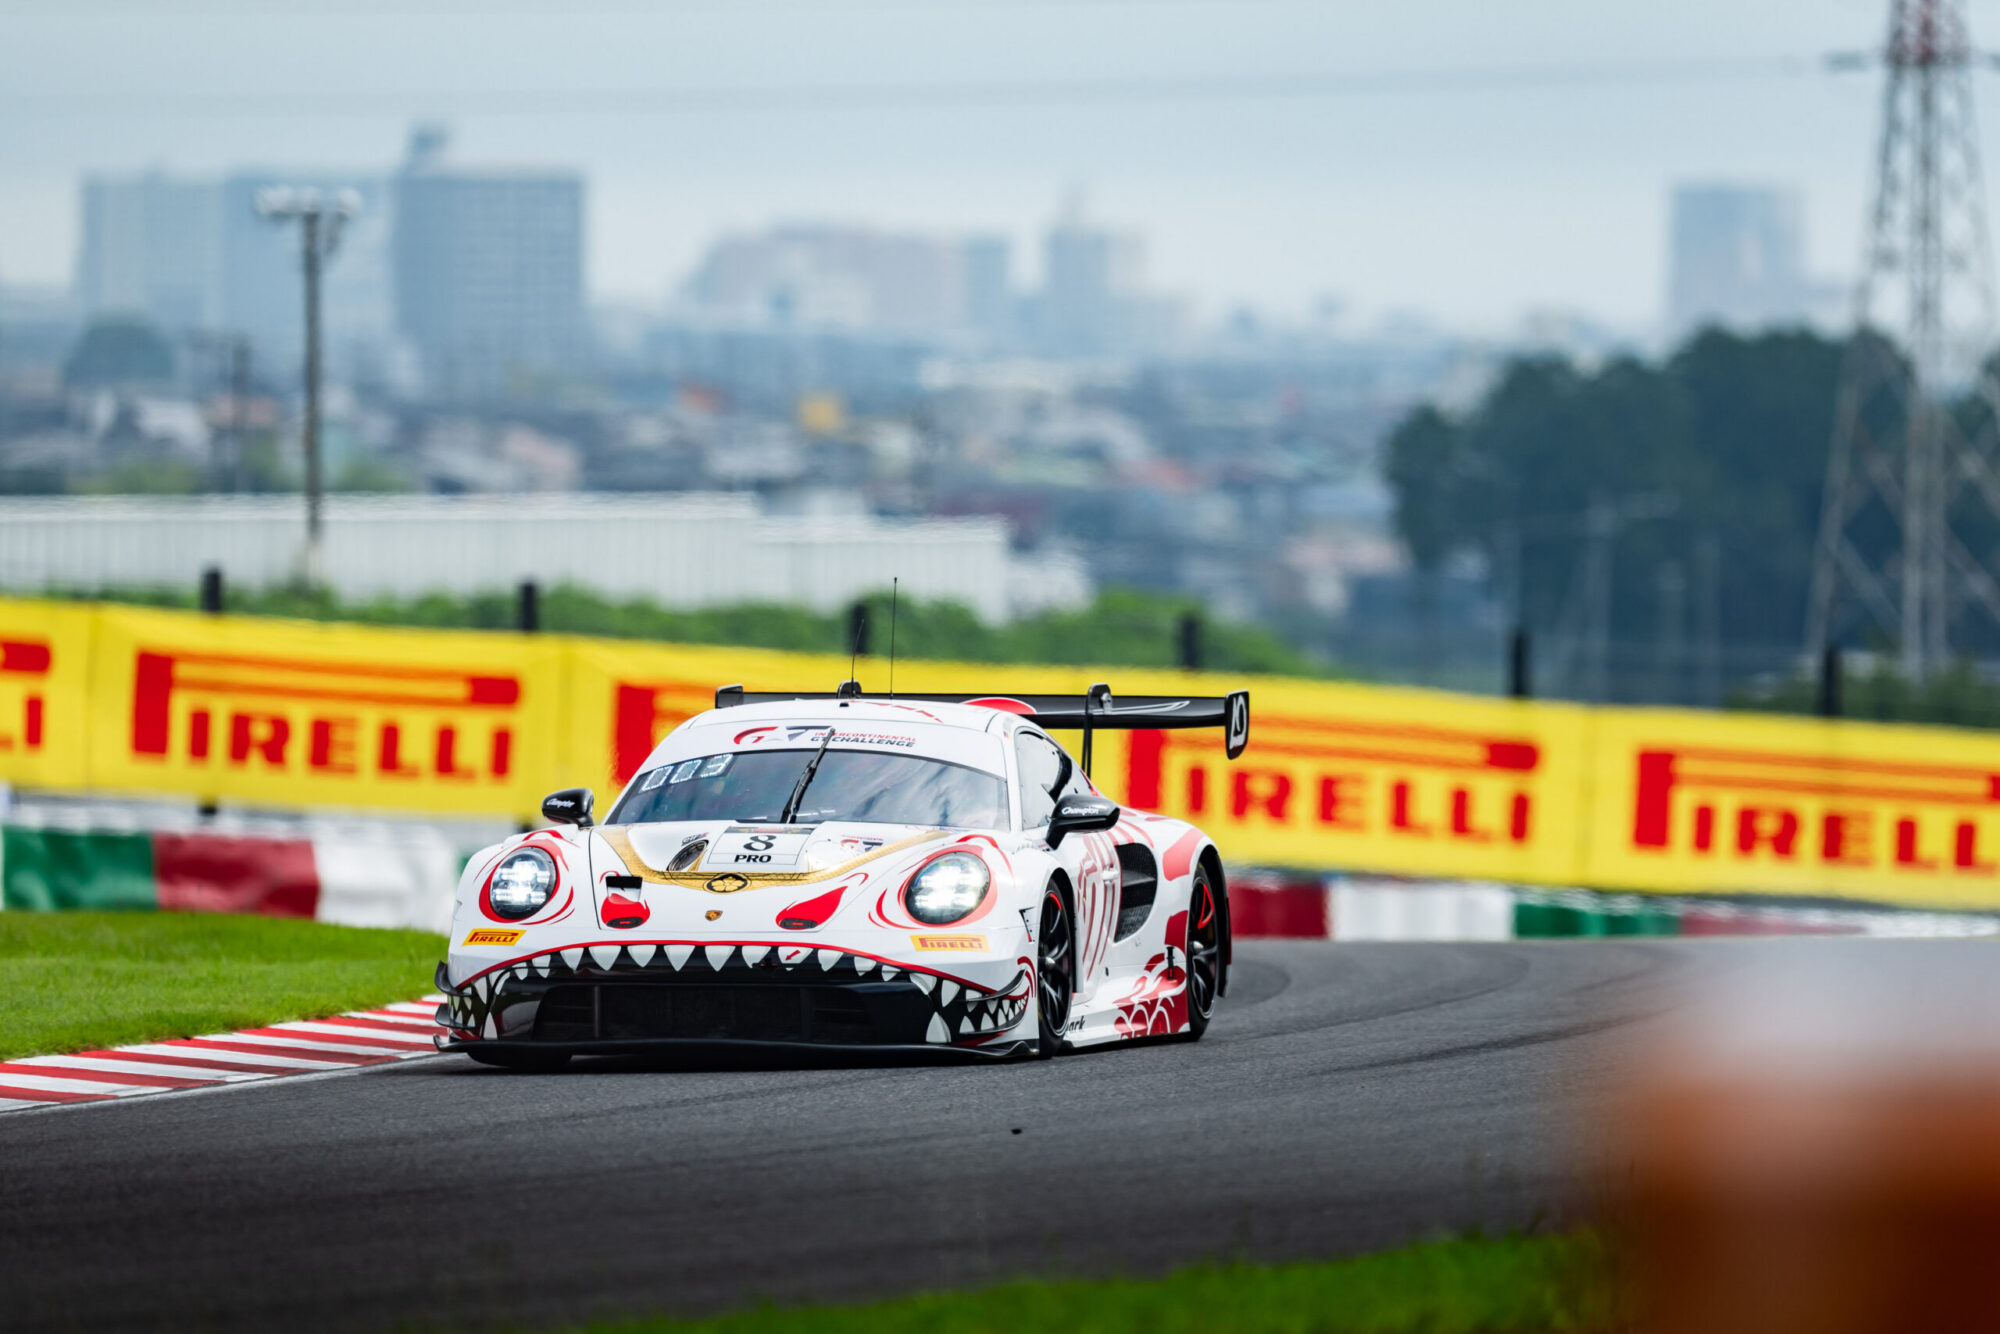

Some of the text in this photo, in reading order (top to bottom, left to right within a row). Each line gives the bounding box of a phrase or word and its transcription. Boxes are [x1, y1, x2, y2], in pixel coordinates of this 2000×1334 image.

[131, 648, 520, 781] PIRELLI
[831, 737, 915, 748] CHALLENGE
[1126, 715, 1539, 843] PIRELLI
[1061, 806, 1099, 815] Champion
[1634, 748, 2000, 868] PIRELL
[743, 834, 777, 852] 8
[734, 854, 772, 863] PRO
[468, 931, 520, 943] PIRELLI
[918, 937, 983, 949] PIRELLI
